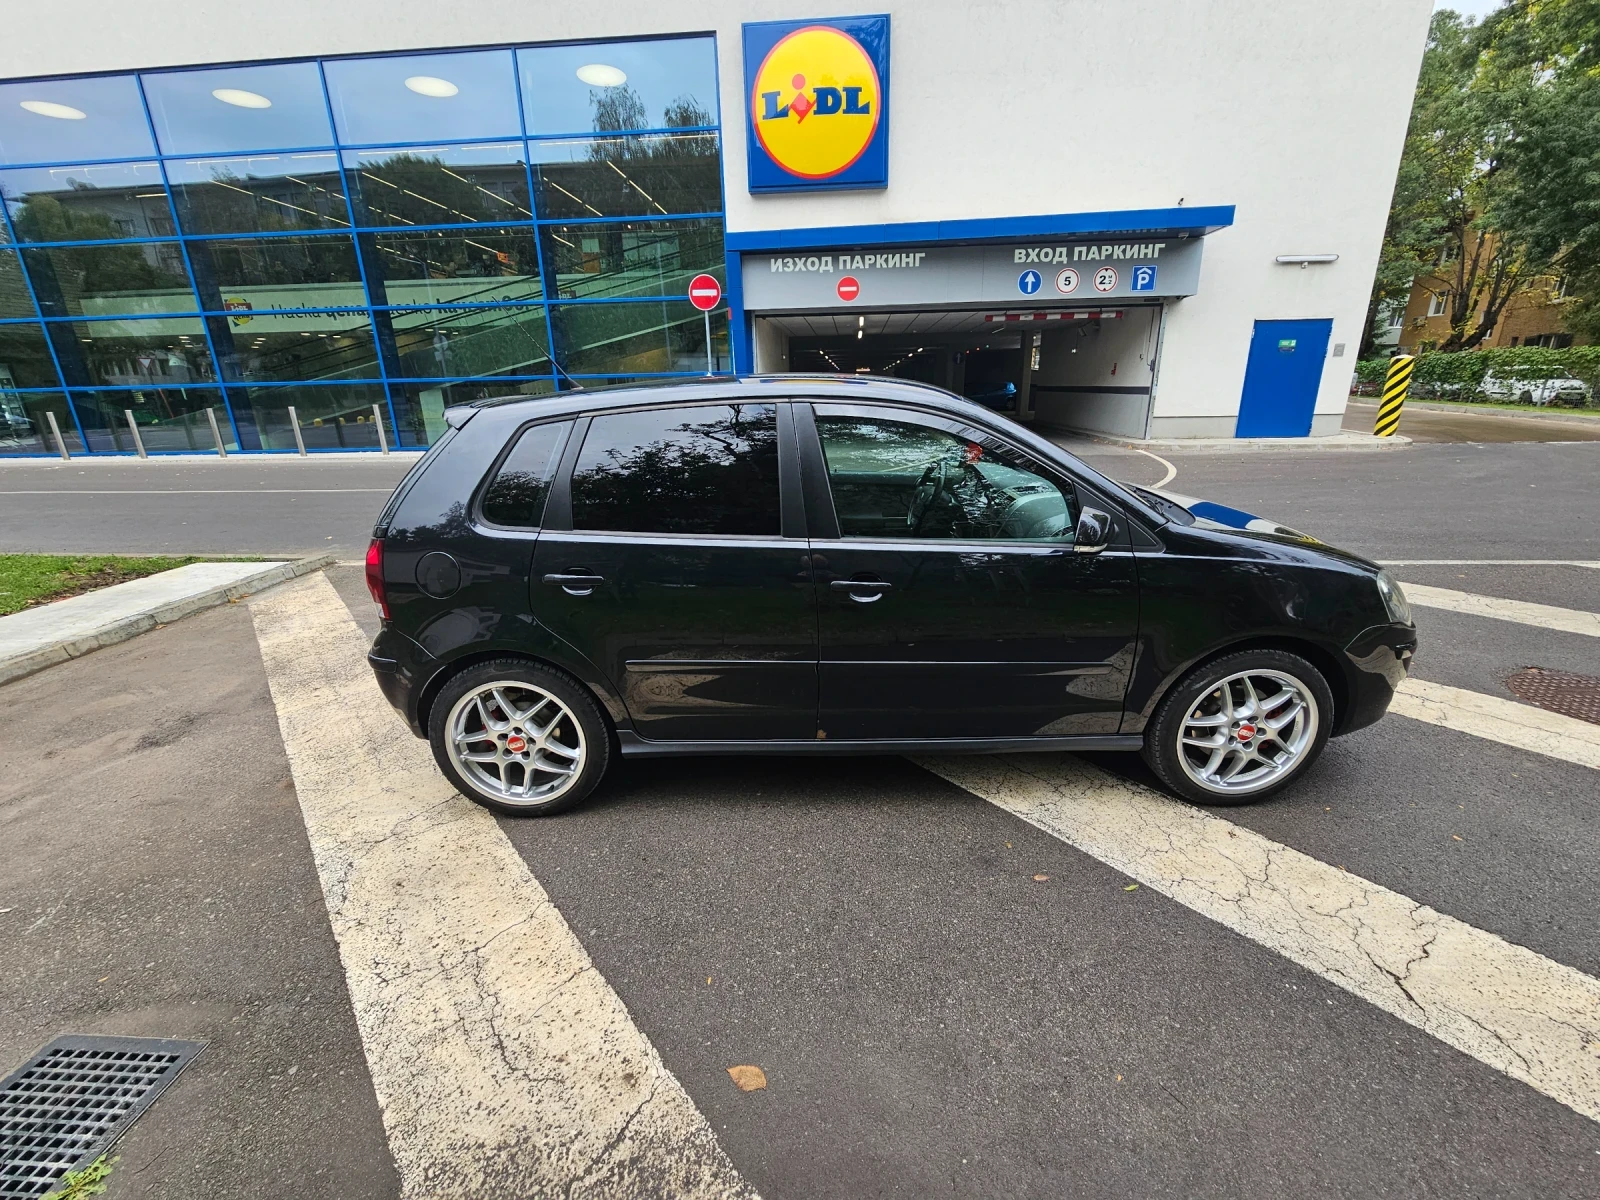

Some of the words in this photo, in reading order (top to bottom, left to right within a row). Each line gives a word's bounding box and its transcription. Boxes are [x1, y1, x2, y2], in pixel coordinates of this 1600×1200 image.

[770, 256, 834, 273] ИЗХОД
[838, 252, 926, 270] ПАРКИНГ
[1014, 247, 1068, 265] ВХОД
[1073, 243, 1166, 261] ПАРКИНГ
[1063, 276, 1071, 286] 5
